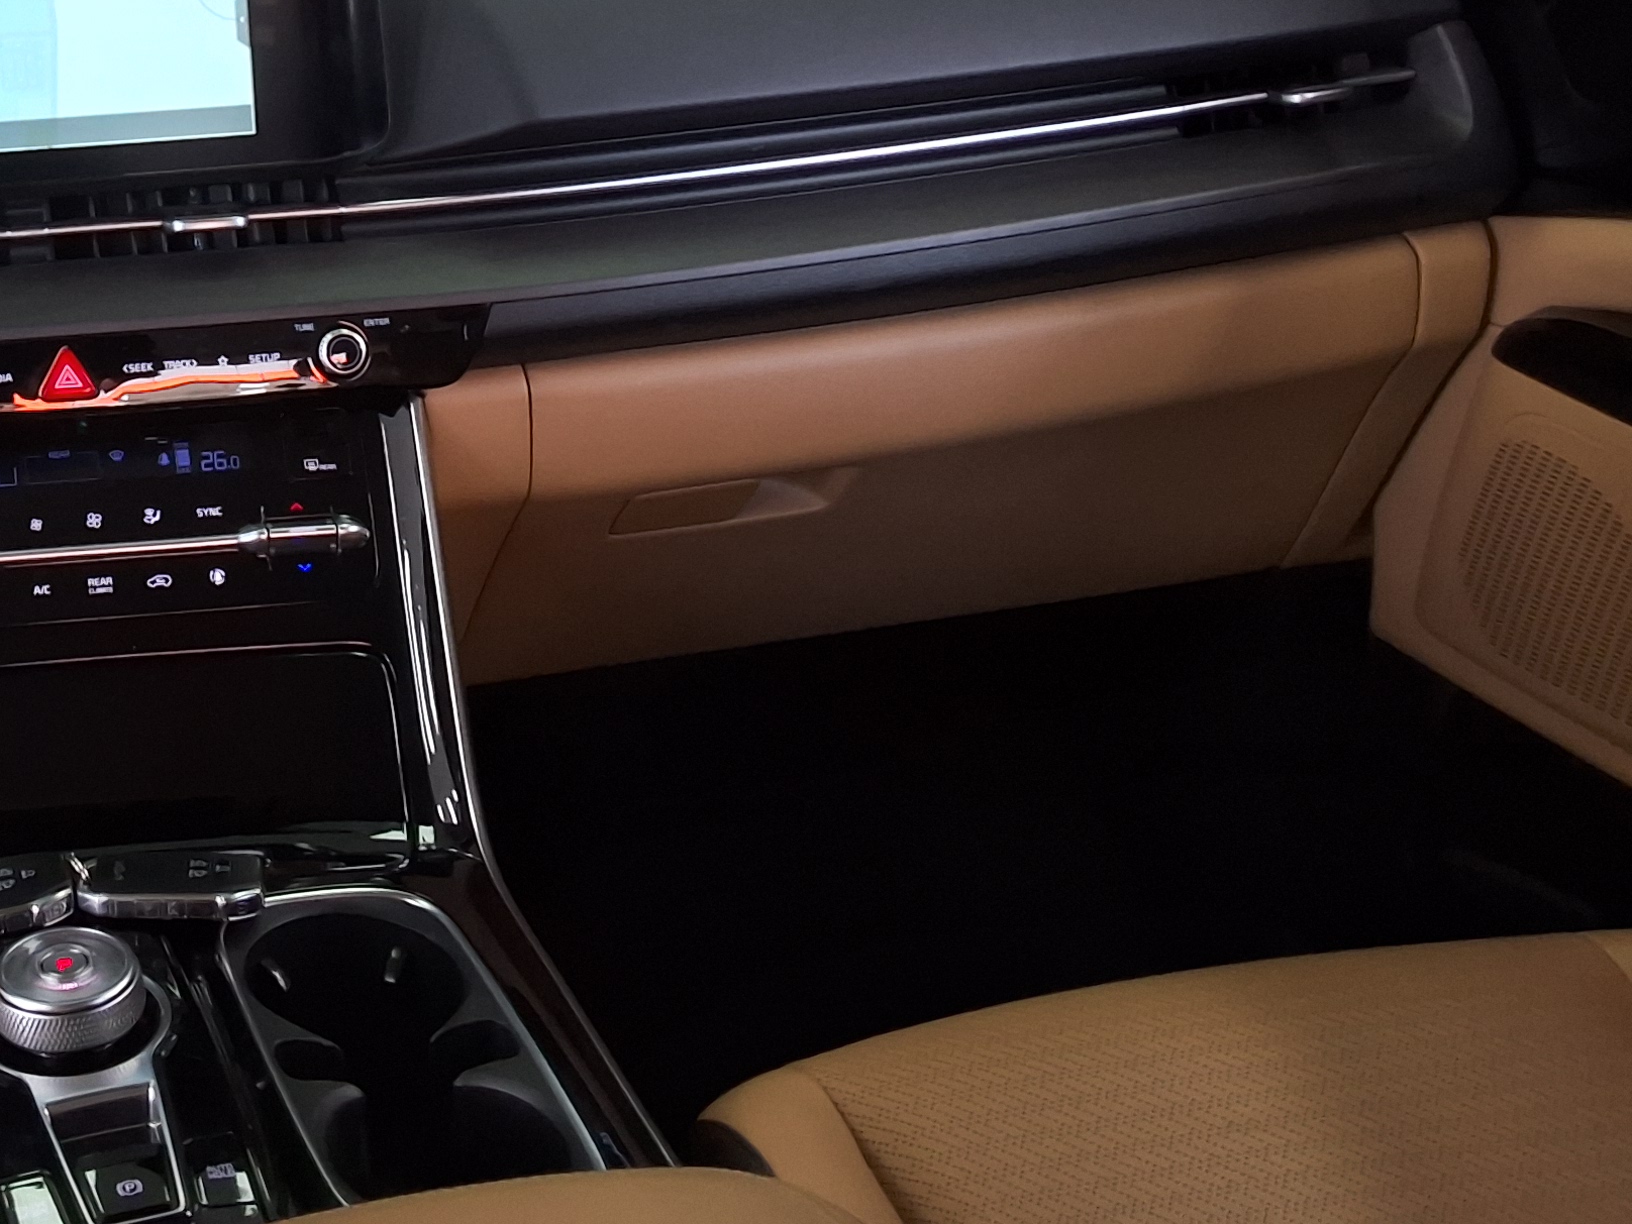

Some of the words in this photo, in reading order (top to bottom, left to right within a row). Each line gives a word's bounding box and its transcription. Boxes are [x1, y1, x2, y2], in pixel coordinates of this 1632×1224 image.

[248, 352, 281, 364] SETUP
[128, 362, 154, 373] SEEK
[200, 450, 241, 472] 26.0
[196, 506, 223, 518] SYNC
[87, 576, 113, 587] REAR
[33, 584, 51, 596] A/C
